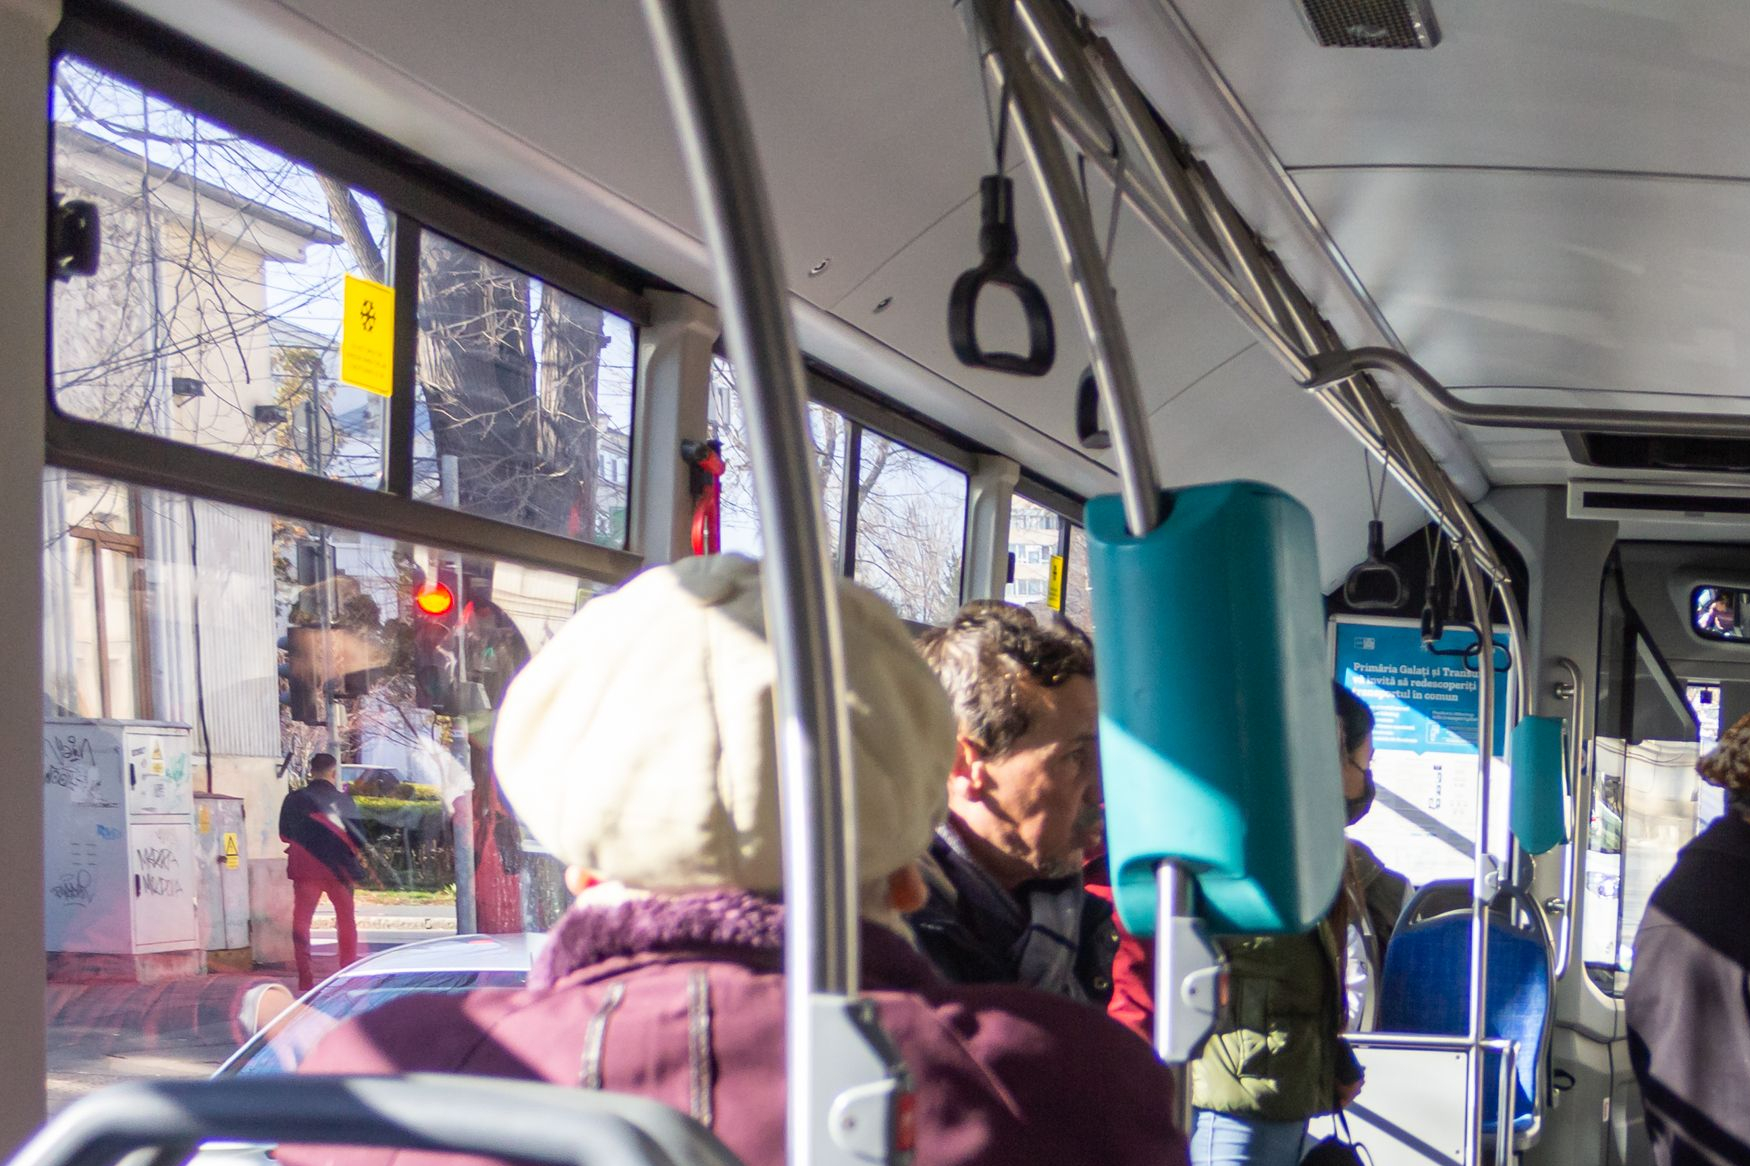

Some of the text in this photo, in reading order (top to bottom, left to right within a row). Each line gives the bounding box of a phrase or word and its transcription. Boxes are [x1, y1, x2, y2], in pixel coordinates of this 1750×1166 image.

[1353, 662, 1480, 678] Primăria Galați și Transu
[1397, 677, 1409, 687] să
[1410, 678, 1477, 691] redescoperiți
[1424, 692, 1459, 702] comun
